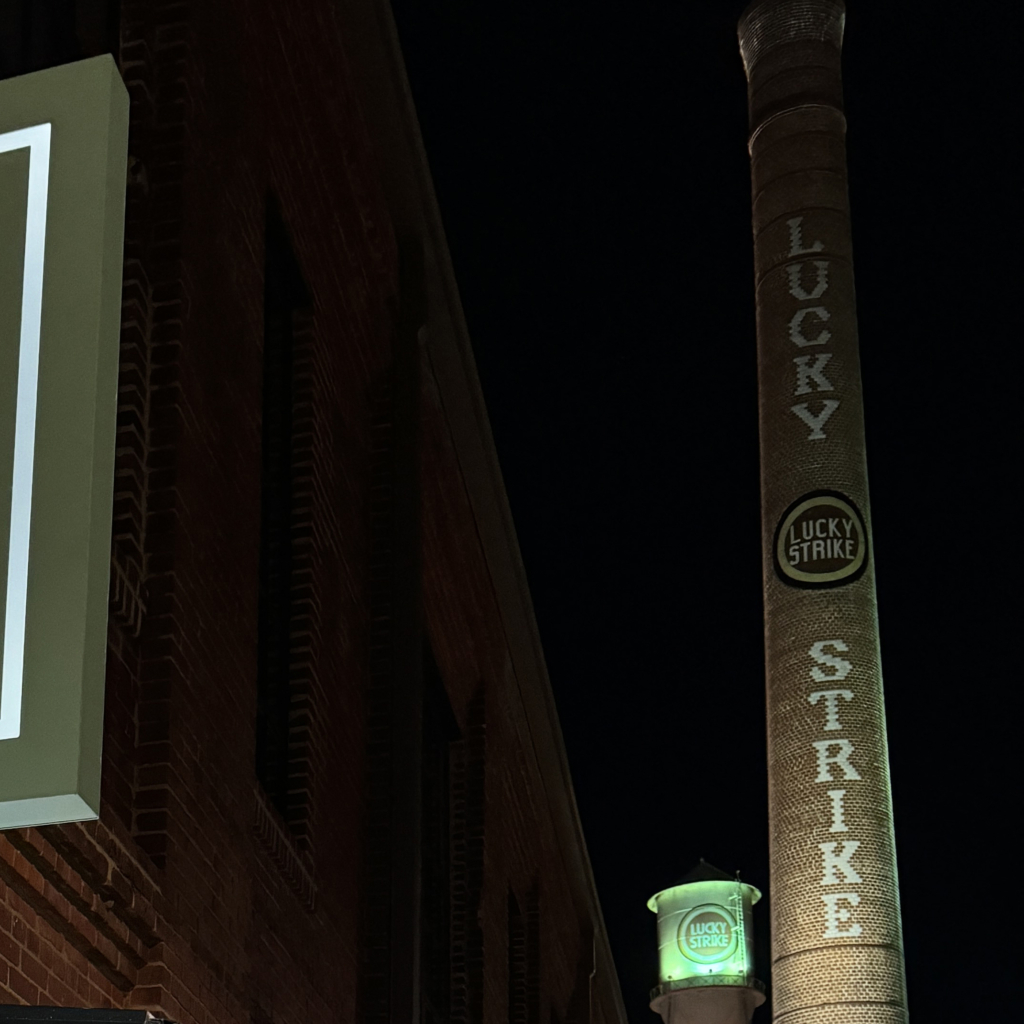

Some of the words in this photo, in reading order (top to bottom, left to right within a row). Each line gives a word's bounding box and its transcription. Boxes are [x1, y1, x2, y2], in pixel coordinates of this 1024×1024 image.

[786, 216, 840, 440] LUCKY
[789, 517, 853, 545] LUCKY
[788, 538, 855, 566] STRIKE
[808, 639, 864, 938] STRIKE
[689, 934, 729, 949] STRIKE
[690, 921, 727, 936] LUCKY
